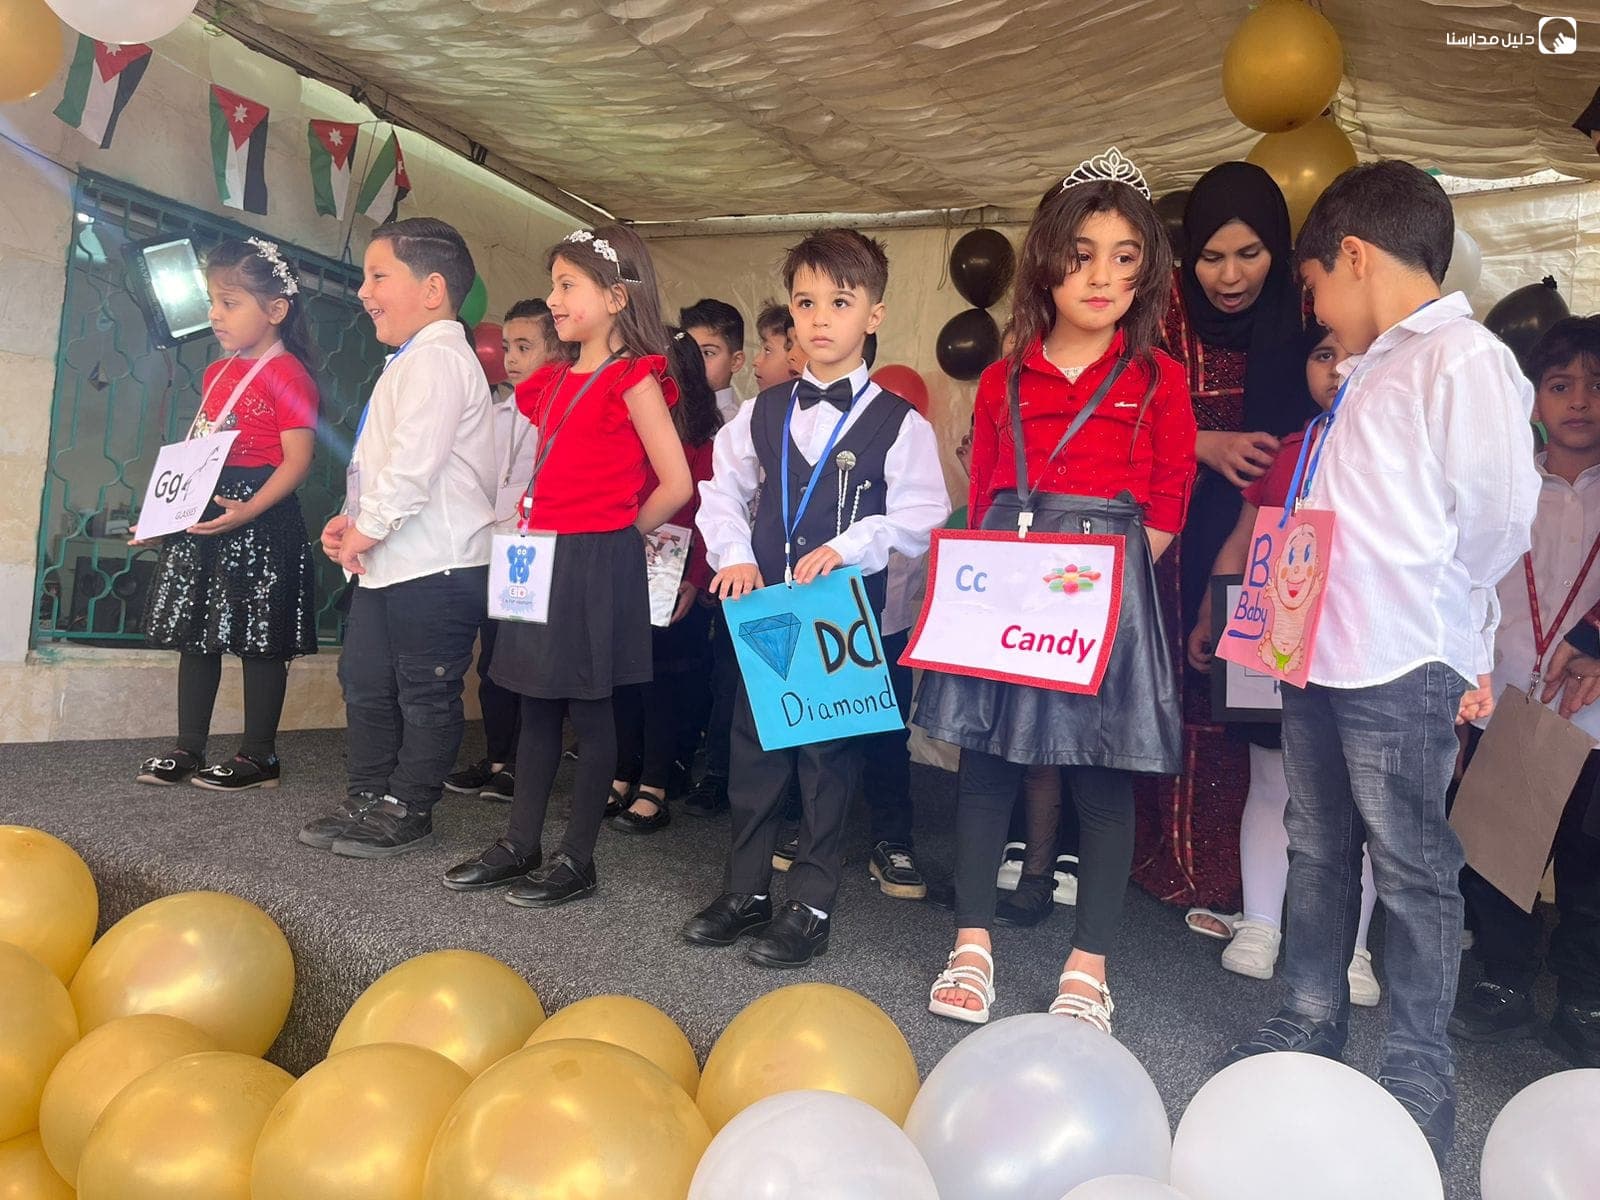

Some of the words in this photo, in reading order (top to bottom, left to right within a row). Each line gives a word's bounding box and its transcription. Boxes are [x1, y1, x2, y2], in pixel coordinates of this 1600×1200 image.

[155, 470, 184, 504] Gg
[955, 564, 988, 593] Cc
[1248, 533, 1272, 588] B
[814, 576, 882, 675] Dd
[1228, 591, 1268, 640] Baby
[1001, 625, 1096, 663] Candy
[781, 675, 897, 727] Diamond
